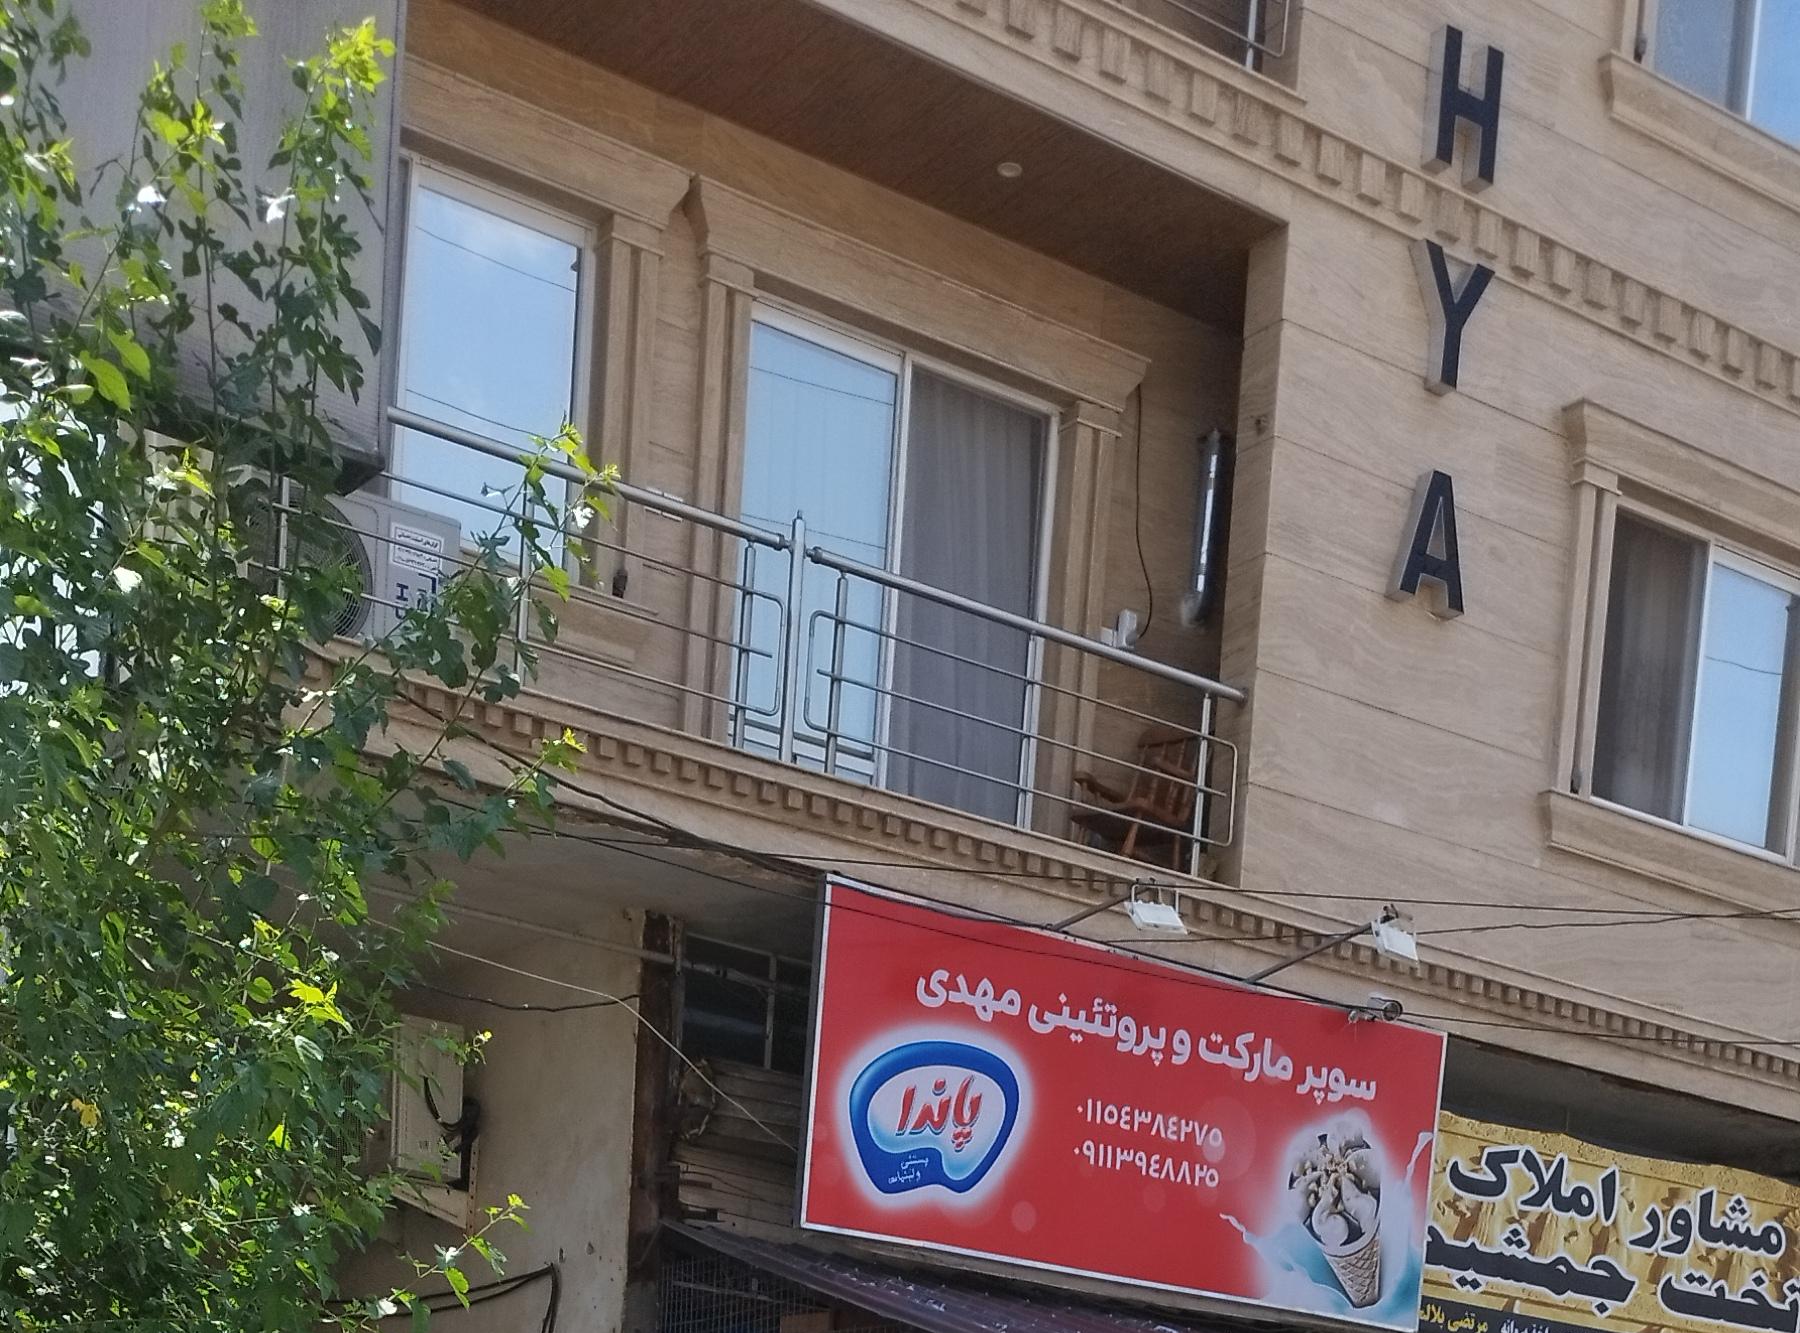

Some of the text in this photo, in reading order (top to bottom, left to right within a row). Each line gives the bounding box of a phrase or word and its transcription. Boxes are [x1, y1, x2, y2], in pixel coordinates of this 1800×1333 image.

[916, 968, 1377, 1105] سوپر مارکت و پروتئینی مهدی
[895, 1074, 983, 1153] پاندا
[1448, 1147, 1785, 1256] مشاور املاک
[1424, 1225, 1637, 1315] جمشید
